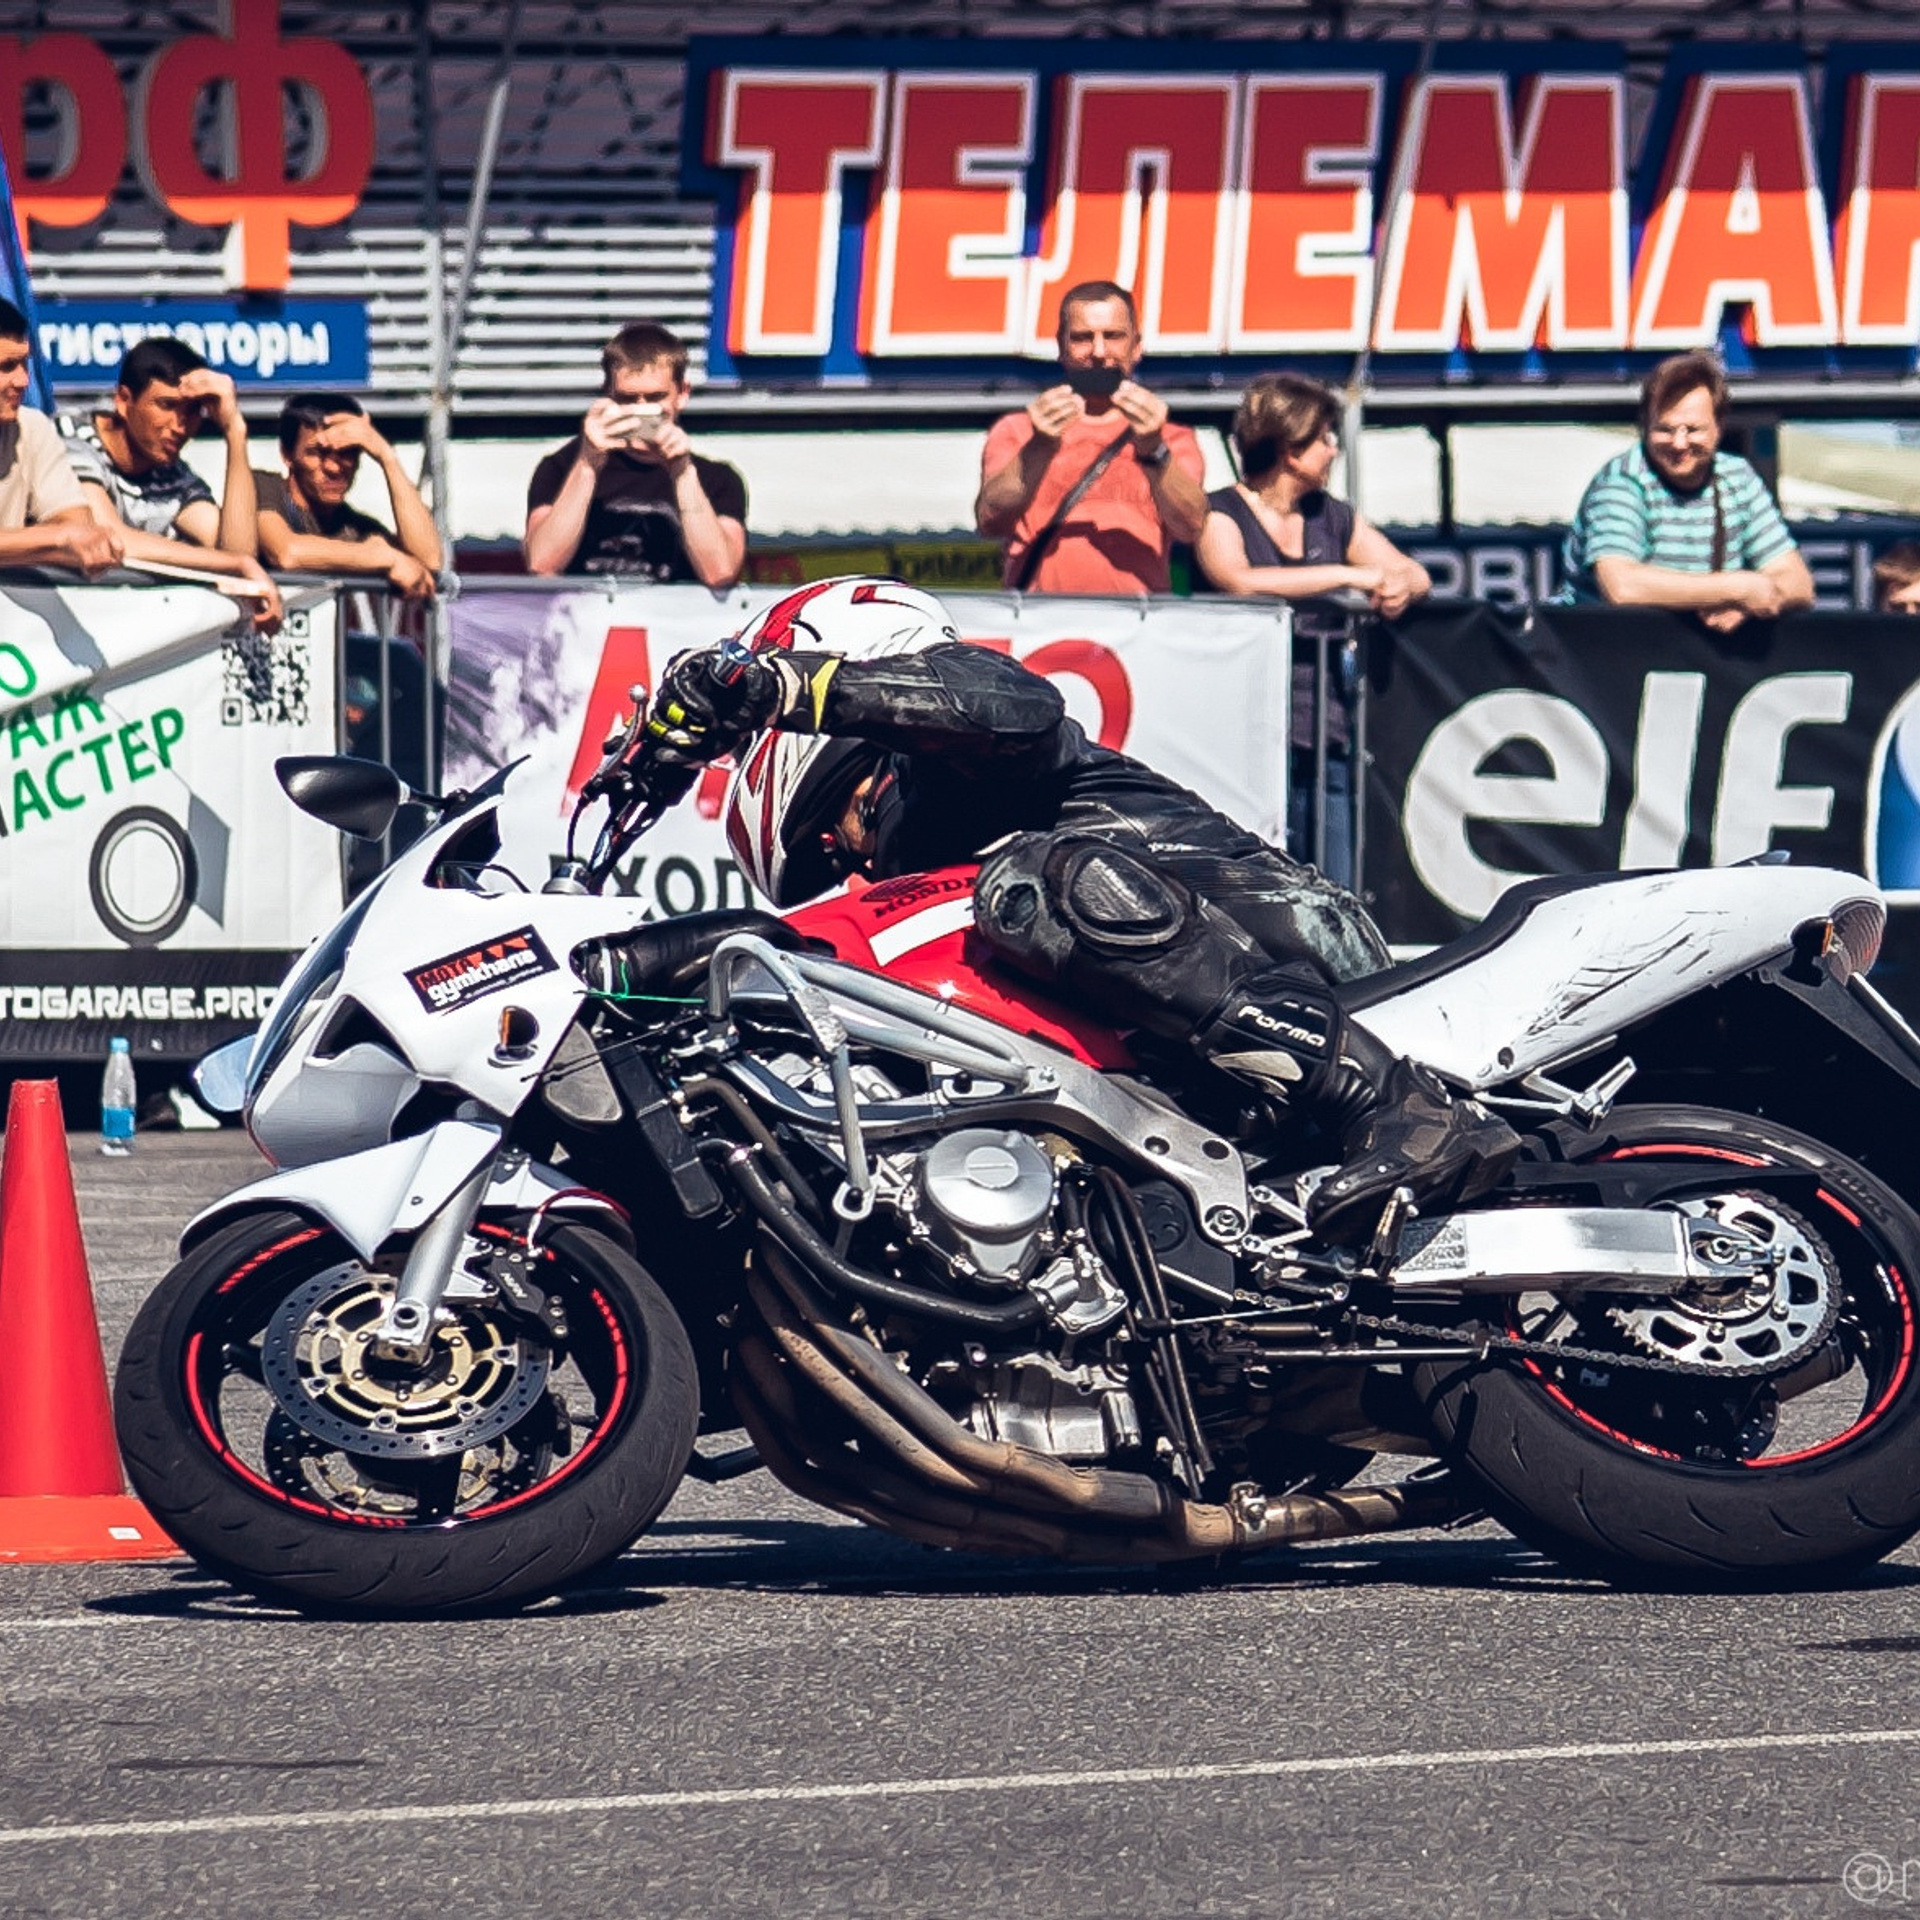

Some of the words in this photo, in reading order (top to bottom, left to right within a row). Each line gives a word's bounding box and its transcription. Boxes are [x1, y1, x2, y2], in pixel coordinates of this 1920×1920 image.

[0, 707, 185, 838] АСТЕР
[1402, 671, 1853, 921] elf
[427, 949, 538, 1007] gymkhana
